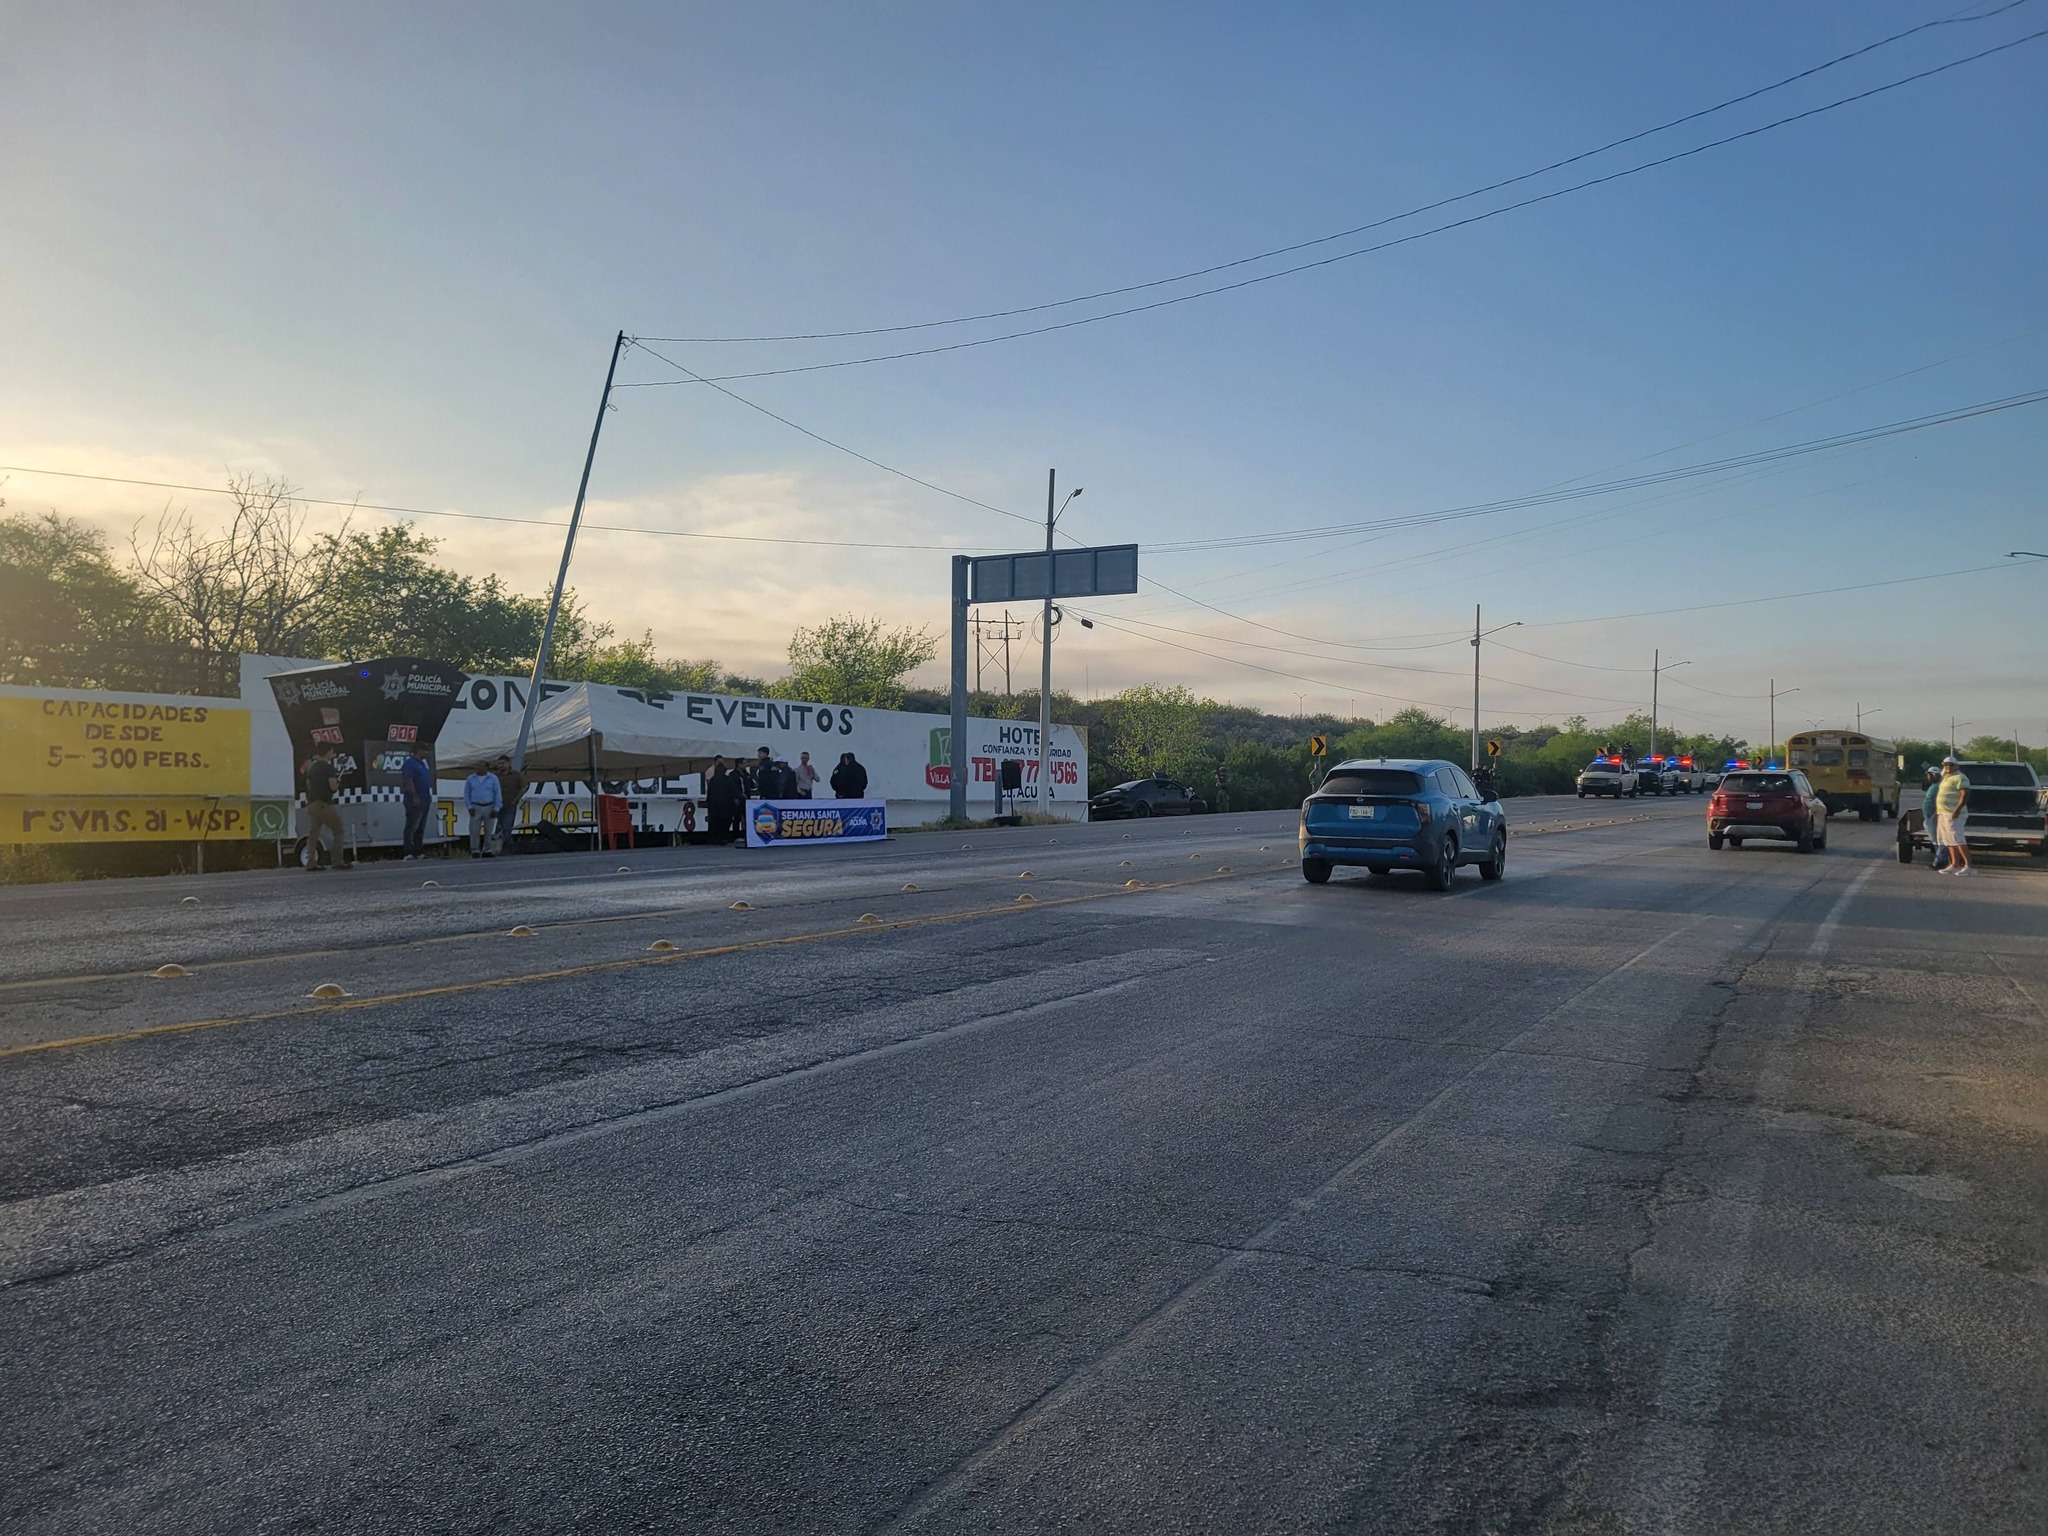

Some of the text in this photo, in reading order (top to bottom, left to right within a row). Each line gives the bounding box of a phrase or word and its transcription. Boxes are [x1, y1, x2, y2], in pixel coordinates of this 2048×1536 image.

[408, 674, 442, 684] POLICÍA
[302, 679, 336, 692] POLICÍA
[407, 682, 452, 692] MUNICIPAL
[303, 686, 350, 698] MUNICIPAL
[42, 699, 209, 723] CAPACIDADES
[687, 696, 854, 735] EVENTOS
[86, 724, 163, 742] DESDE
[312, 730, 341, 742] 911
[389, 727, 417, 739] 911
[1000, 726, 1054, 746] HOTE
[982, 744, 1026, 756] CONFIANZA
[1027, 748, 1035, 756] Y
[143, 751, 210, 769] PERS.
[929, 772, 950, 784] VILLA
[1017, 786, 1055, 799] ACUA
[781, 810, 841, 820] SEMANA SANTA
[781, 819, 843, 837] SEGURA
